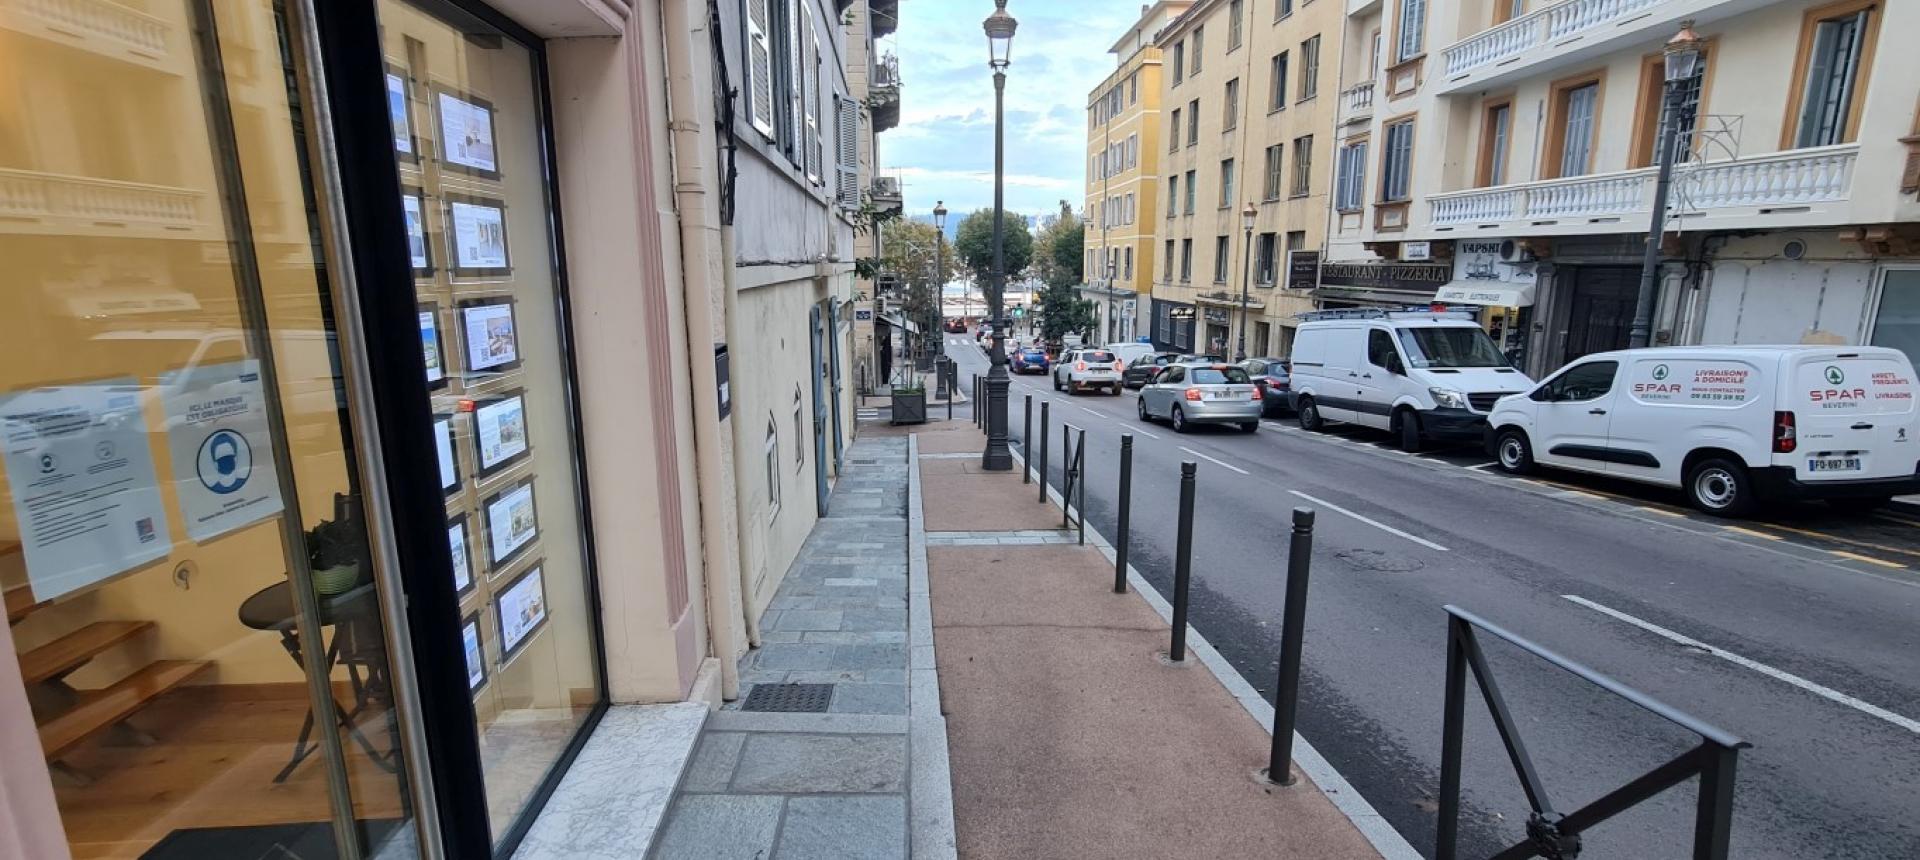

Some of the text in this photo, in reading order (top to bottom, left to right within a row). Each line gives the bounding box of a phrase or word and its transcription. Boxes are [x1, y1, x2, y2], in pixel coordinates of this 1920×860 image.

[1463, 243, 1500, 253] VAPSHI
[1391, 266, 1445, 282] PIZZERIA
[1695, 369, 1749, 378] LIVRAISONS
[1634, 383, 1682, 393] SPAR
[1810, 389, 1866, 401] SPAR
